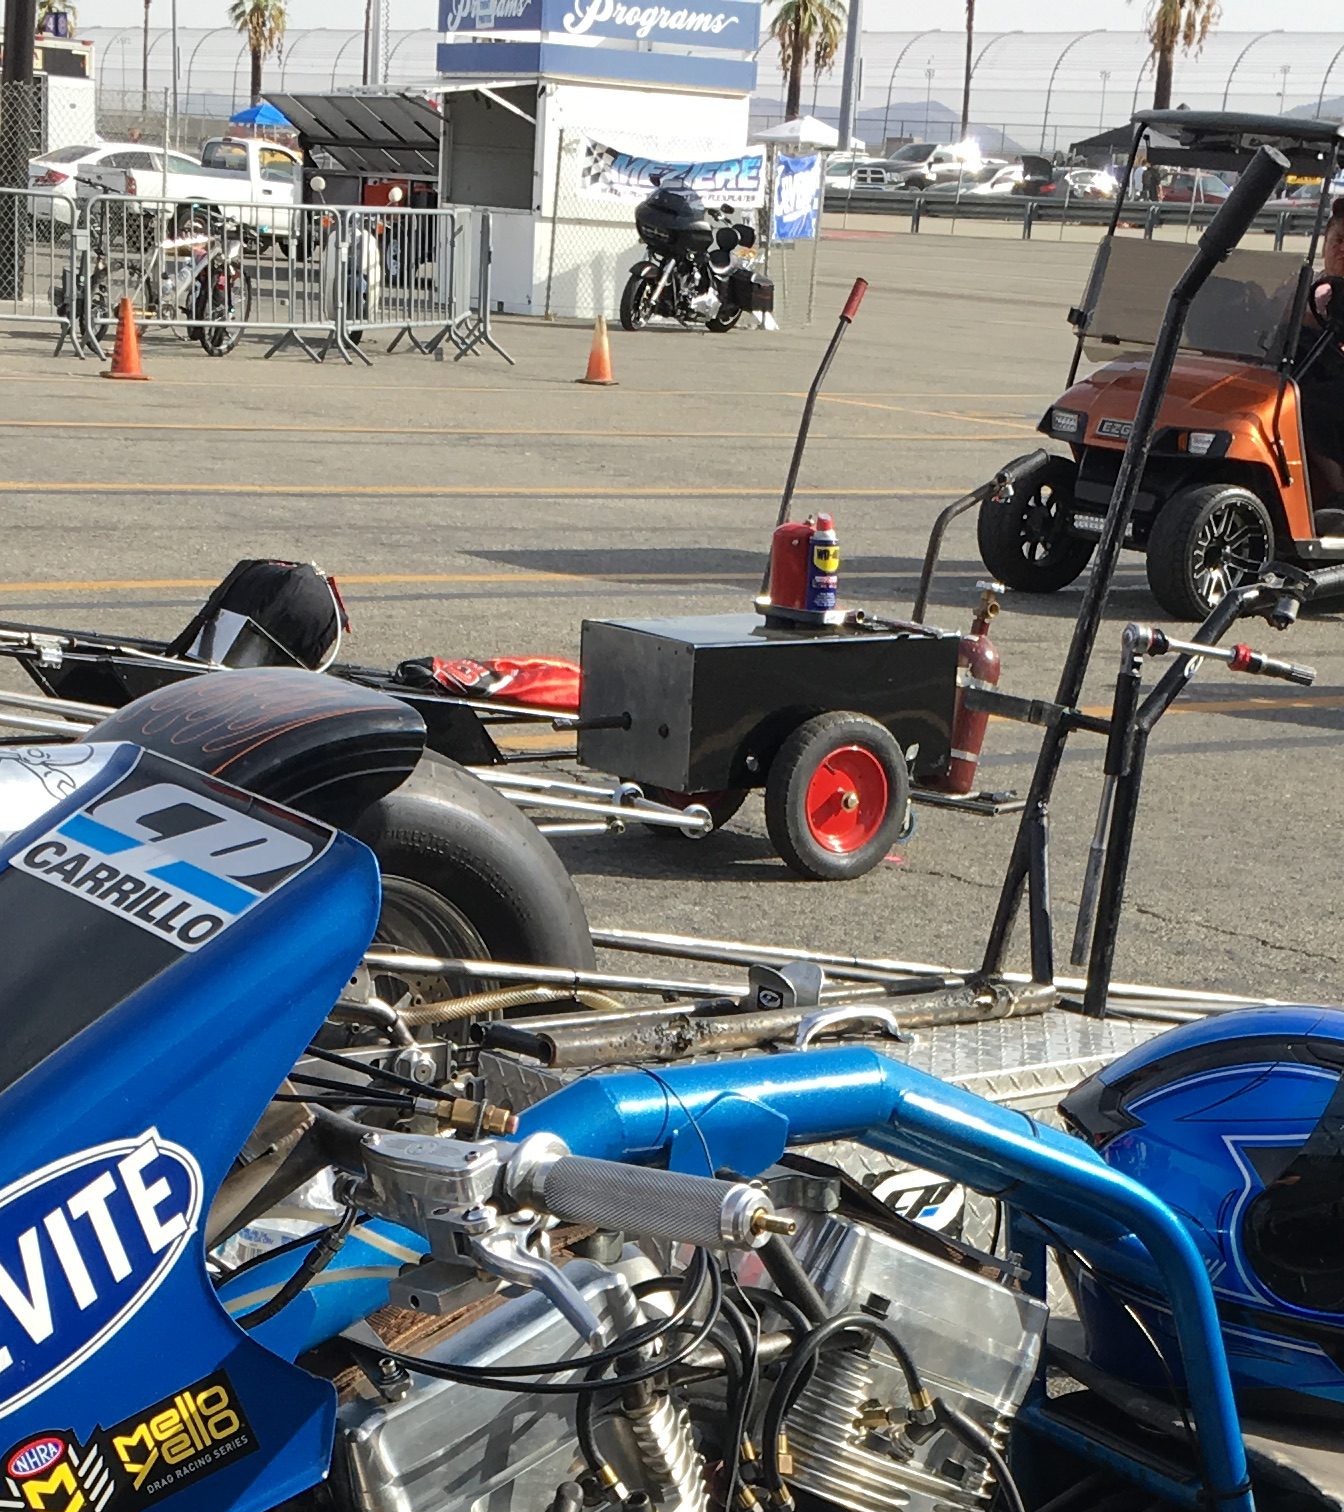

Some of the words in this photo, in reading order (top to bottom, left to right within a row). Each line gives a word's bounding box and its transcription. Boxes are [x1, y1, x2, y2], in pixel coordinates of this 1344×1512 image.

[563, 0, 738, 37] Programs
[22, 840, 225, 945] CARRILLO
[15, 1441, 59, 1473] NHRA
[146, 1476, 174, 1495] DRAG
[175, 1456, 213, 1480] RACING
[213, 1434, 248, 1462] SERIES
